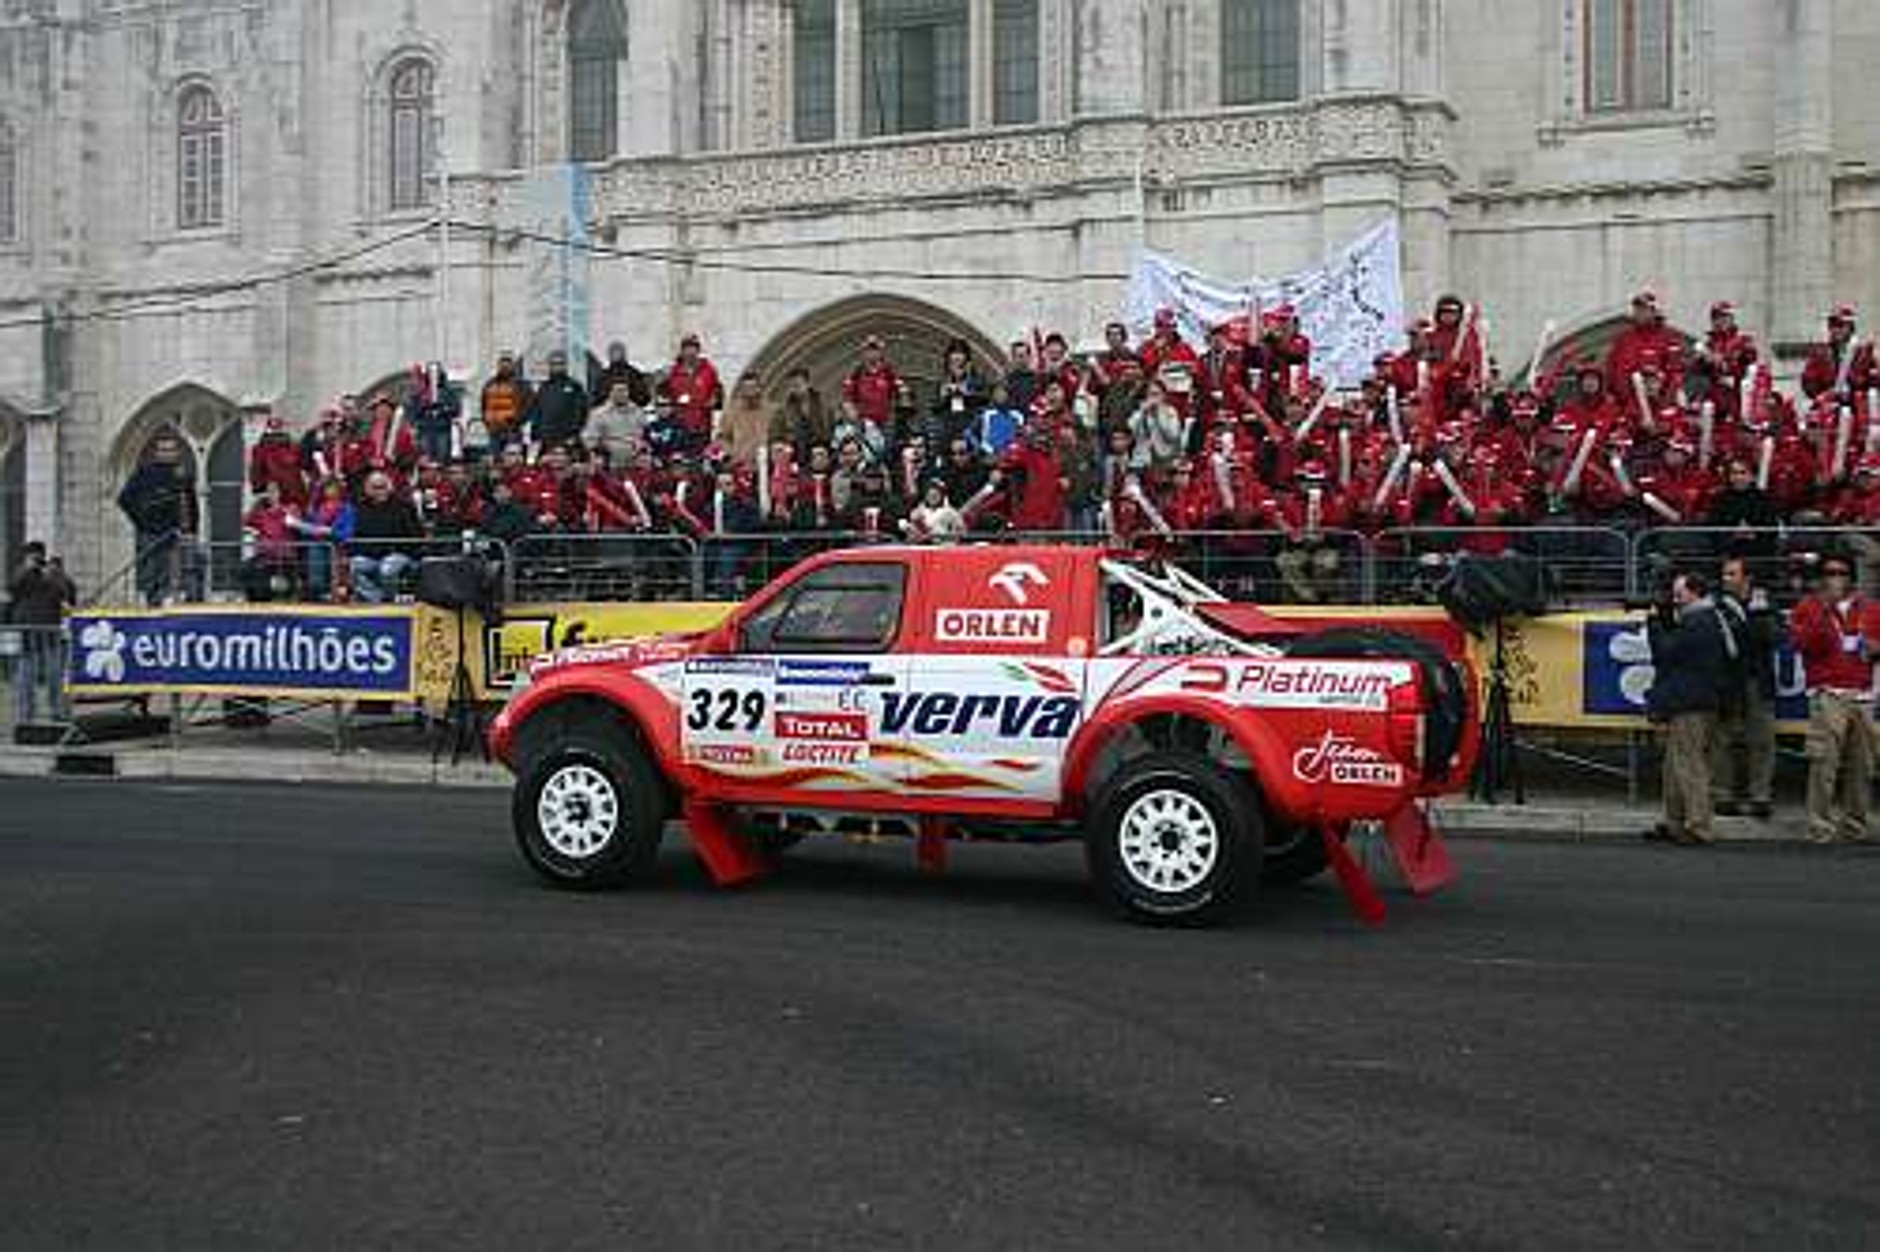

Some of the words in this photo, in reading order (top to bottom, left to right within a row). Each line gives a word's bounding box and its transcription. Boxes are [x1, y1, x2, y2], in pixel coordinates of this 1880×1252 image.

[943, 612, 1040, 637] ORLEN
[133, 627, 395, 673] euromilhões
[1236, 664, 1392, 694] Platinum
[687, 687, 766, 731] 329
[880, 692, 1082, 738] verva
[782, 717, 861, 737] TOTAL
[1334, 764, 1397, 782] ORLEN
